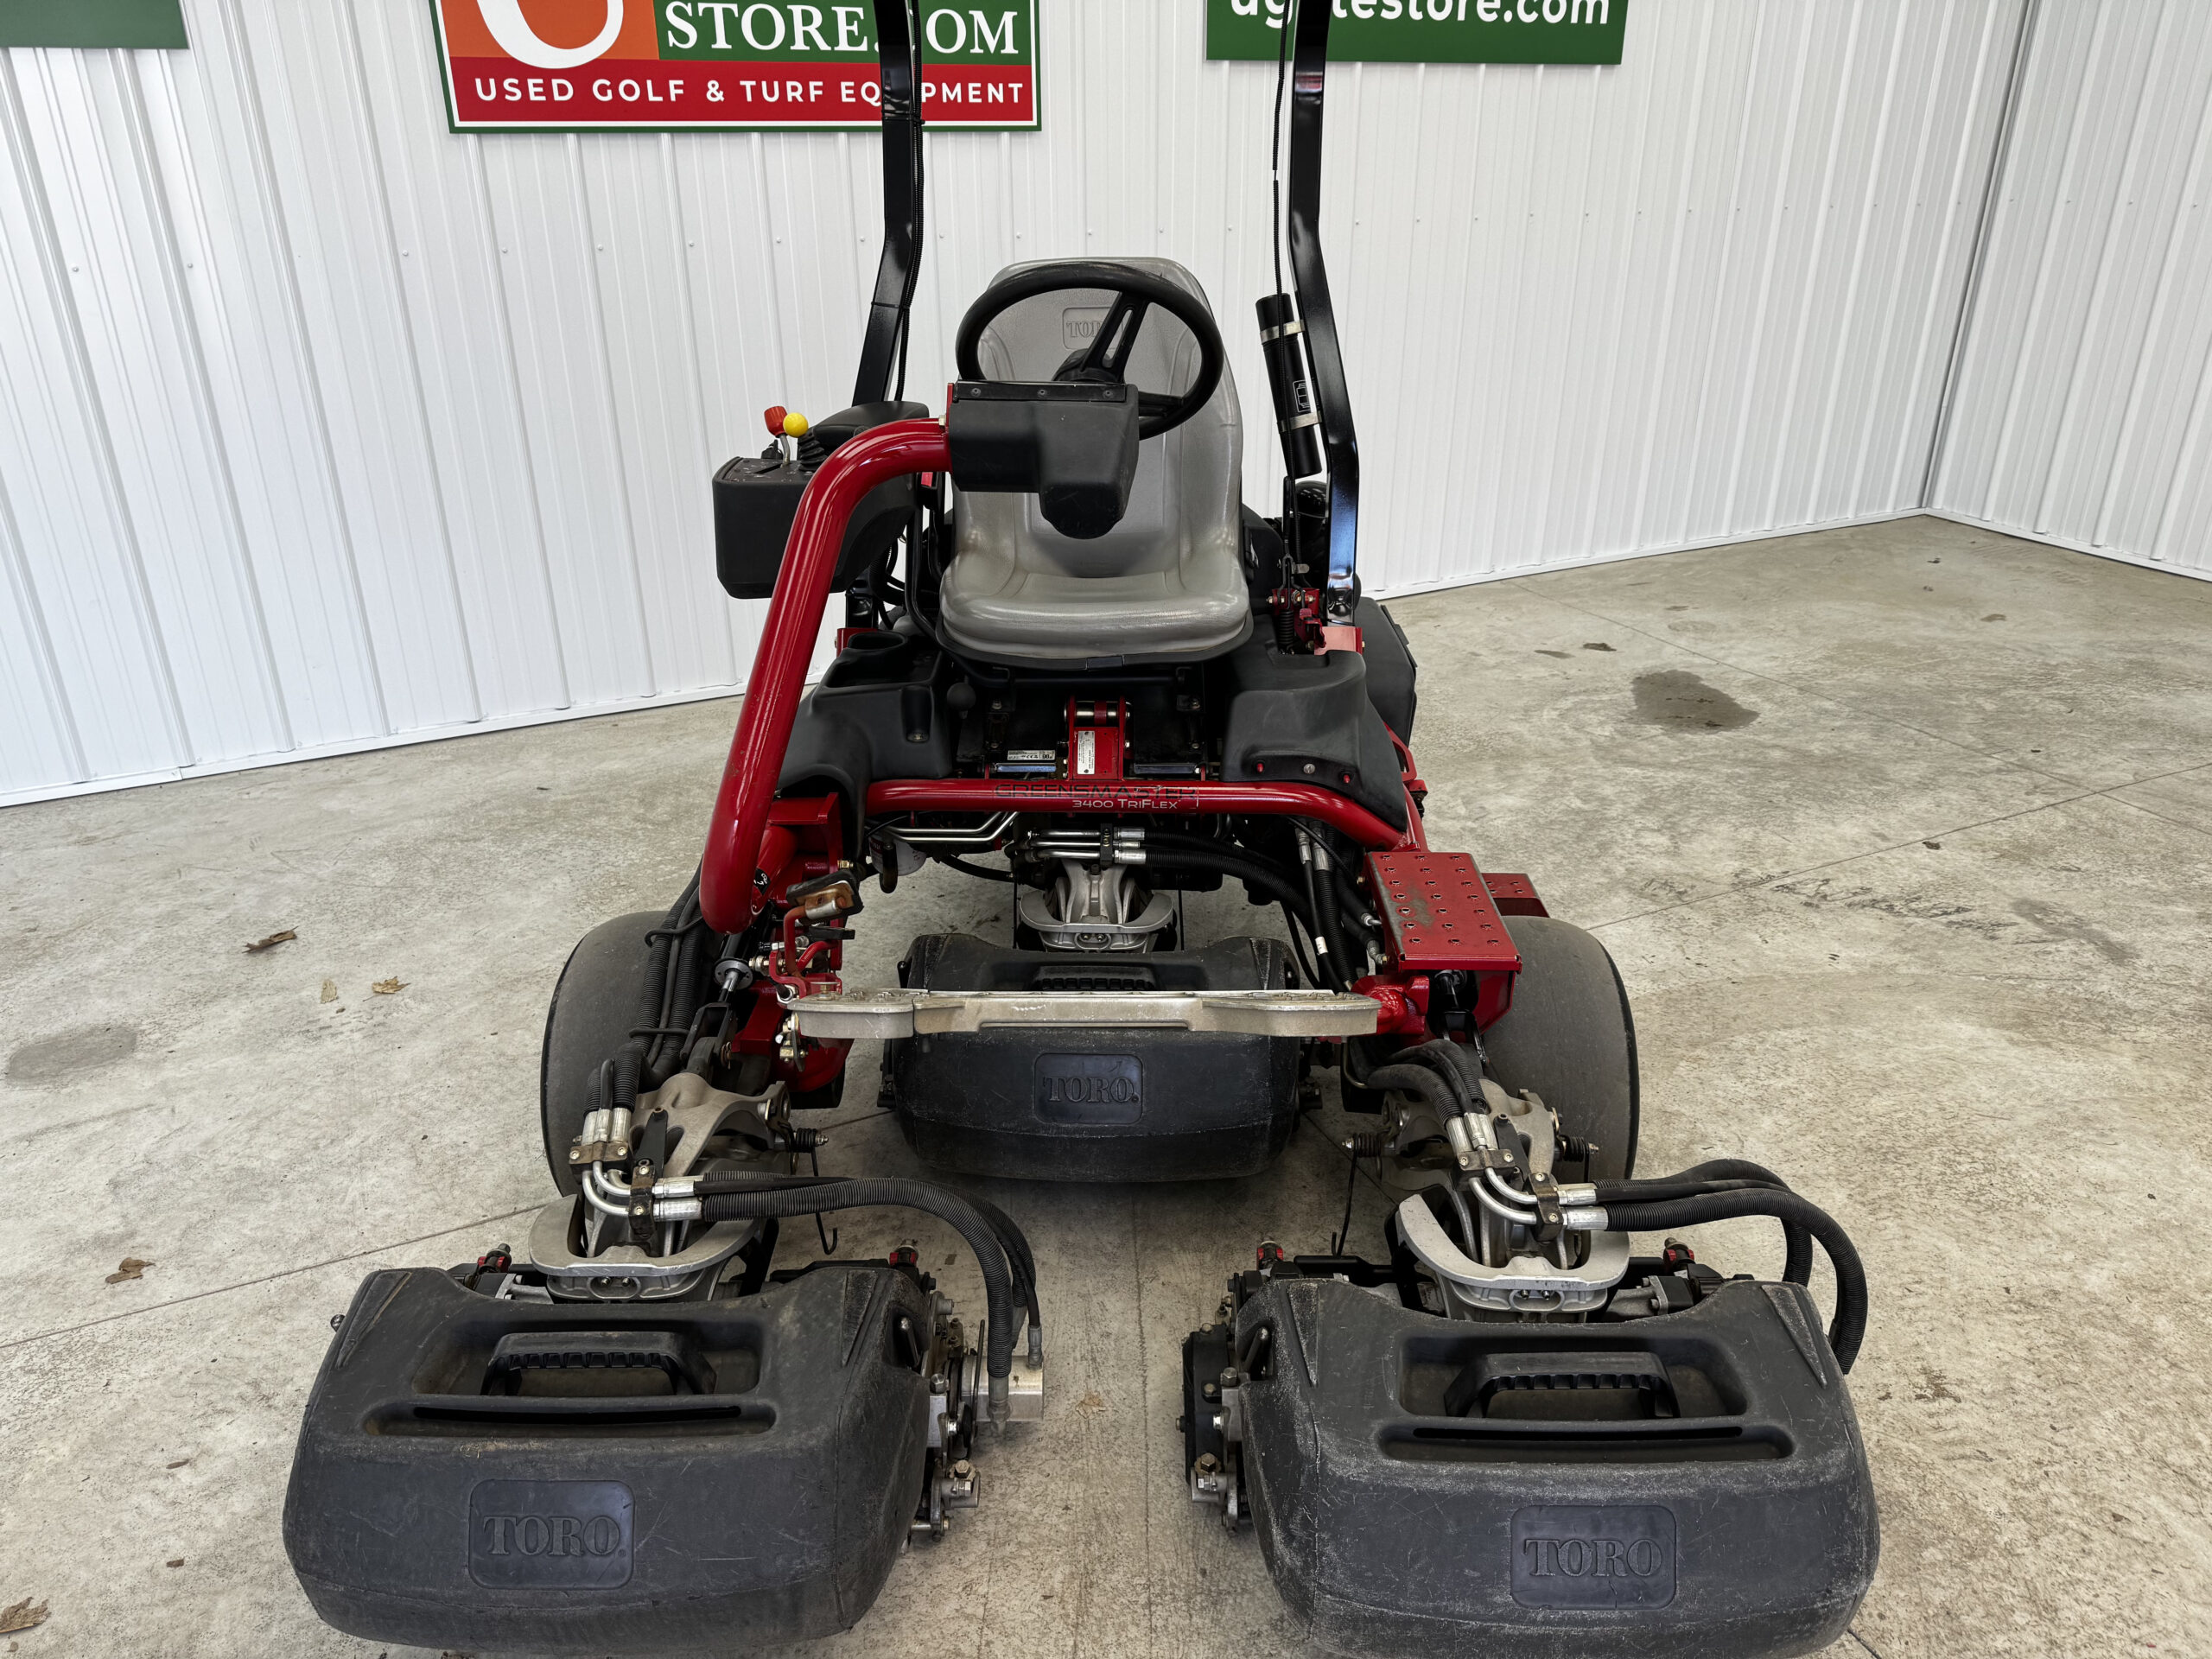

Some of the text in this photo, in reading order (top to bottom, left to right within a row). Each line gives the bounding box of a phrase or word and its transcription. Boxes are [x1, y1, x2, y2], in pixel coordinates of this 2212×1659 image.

[664, 1, 1020, 54] STOREOM
[474, 78, 1023, 107] USED GOLF & TURF EQPMENT
[995, 784, 1197, 800] GREENSMASTER
[1071, 799, 1114, 809] 3400
[1042, 1076, 1135, 1103] TORO
[483, 1515, 621, 1556] TORO
[1523, 1538, 1663, 1577] TORO
